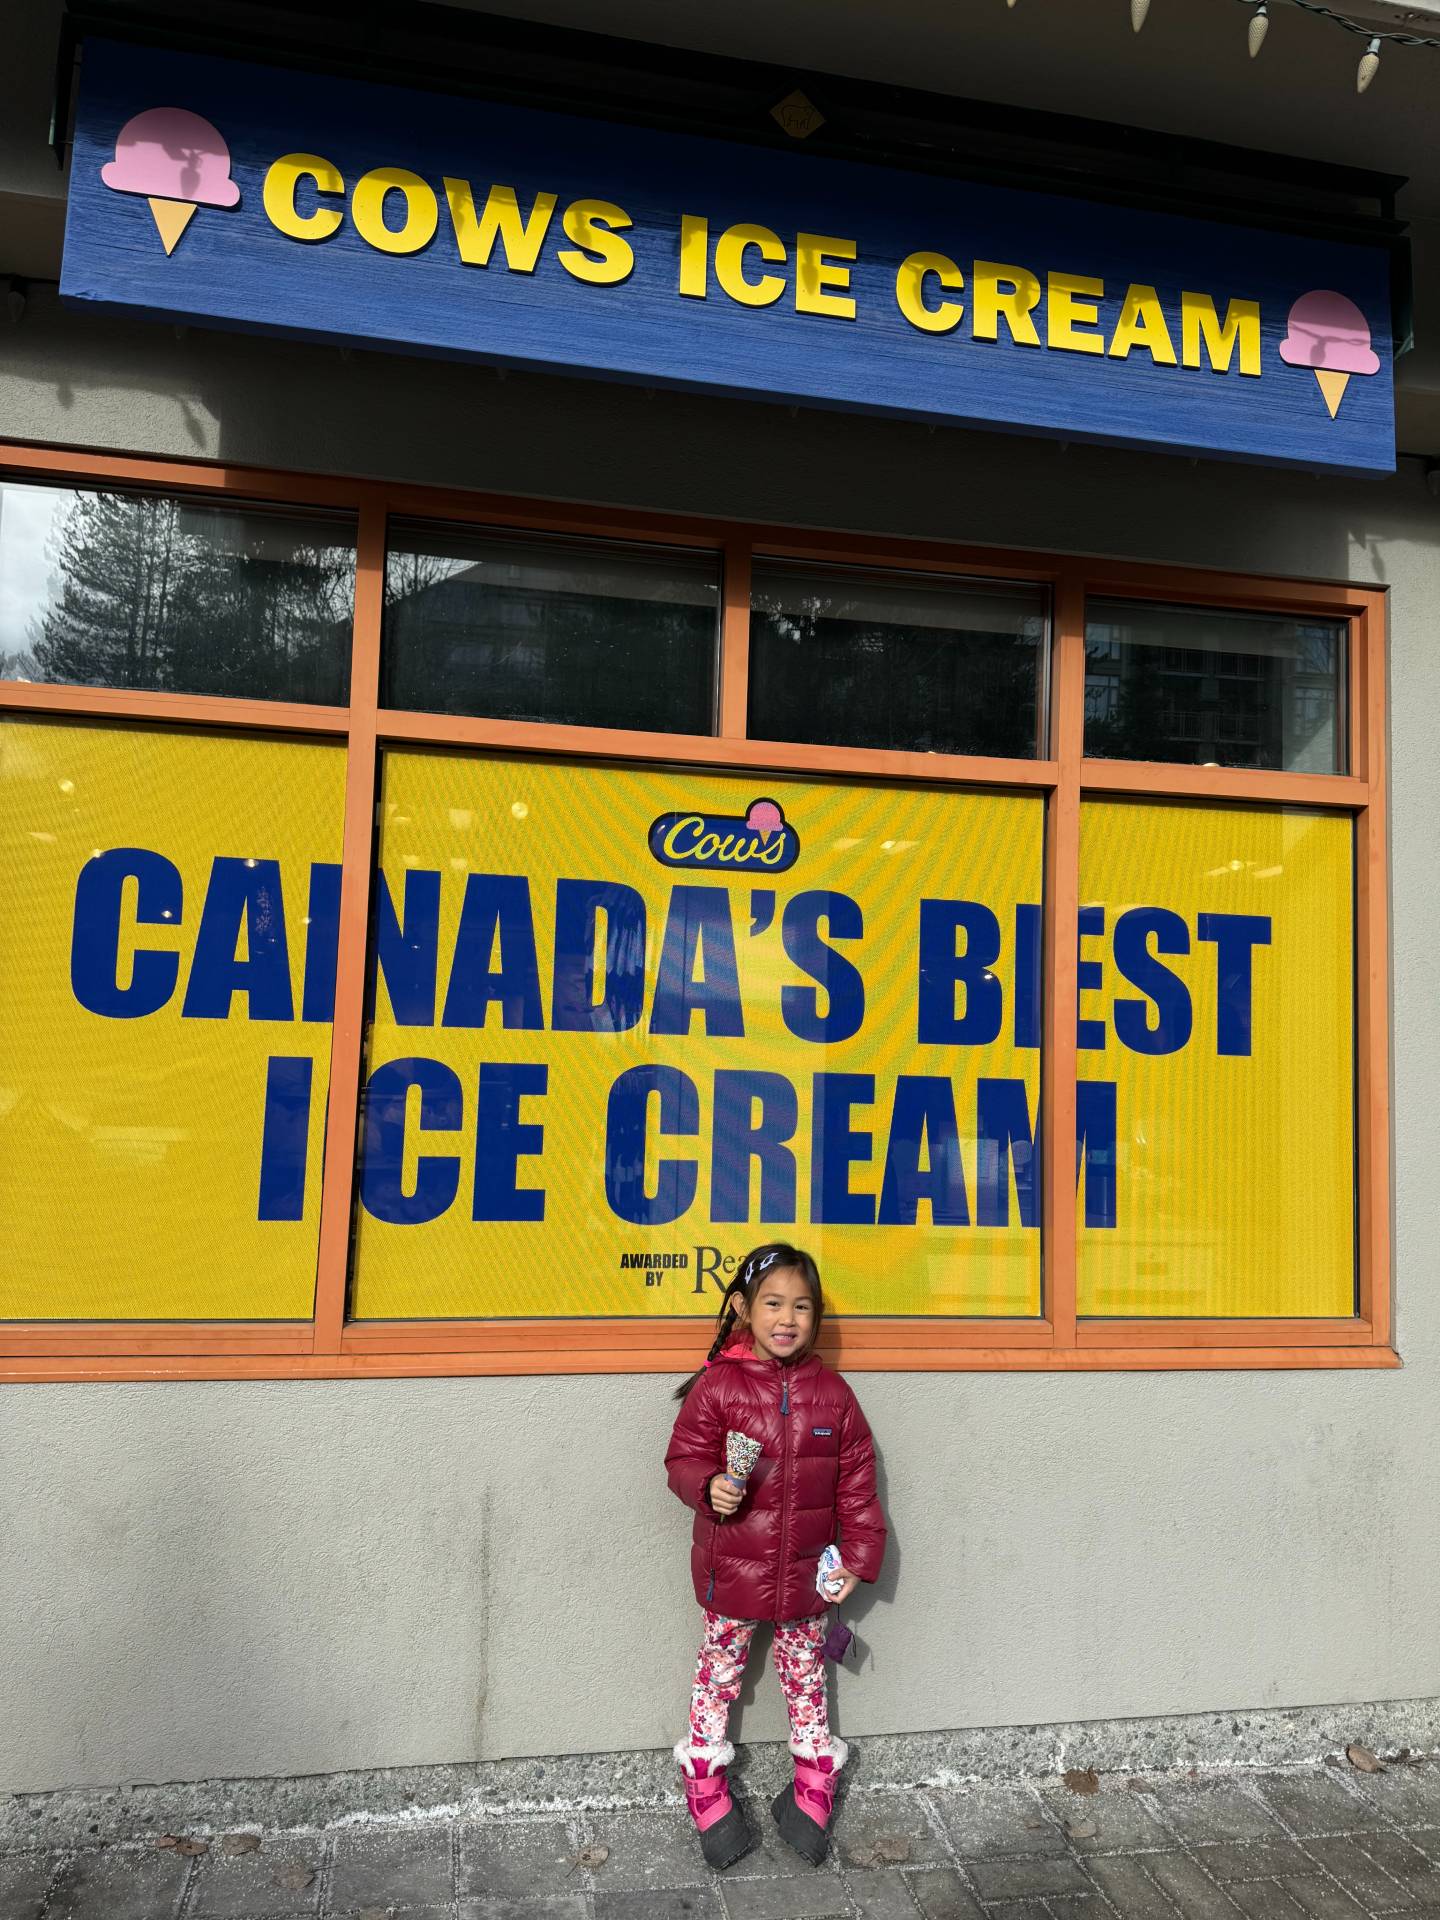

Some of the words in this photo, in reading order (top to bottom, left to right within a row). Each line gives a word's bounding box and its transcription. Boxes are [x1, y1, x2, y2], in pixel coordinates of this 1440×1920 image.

[263, 153, 635, 285] COWS
[679, 214, 857, 320] ICE
[895, 252, 1262, 377] CREAM
[71, 848, 865, 1044] CANADA'S
[918, 899, 1272, 1057] BEST
[258, 1056, 549, 1225] ICE
[604, 1064, 1117, 1229] CREAM
[620, 1253, 688, 1269] AWARDED
[645, 1271, 664, 1287] BY
